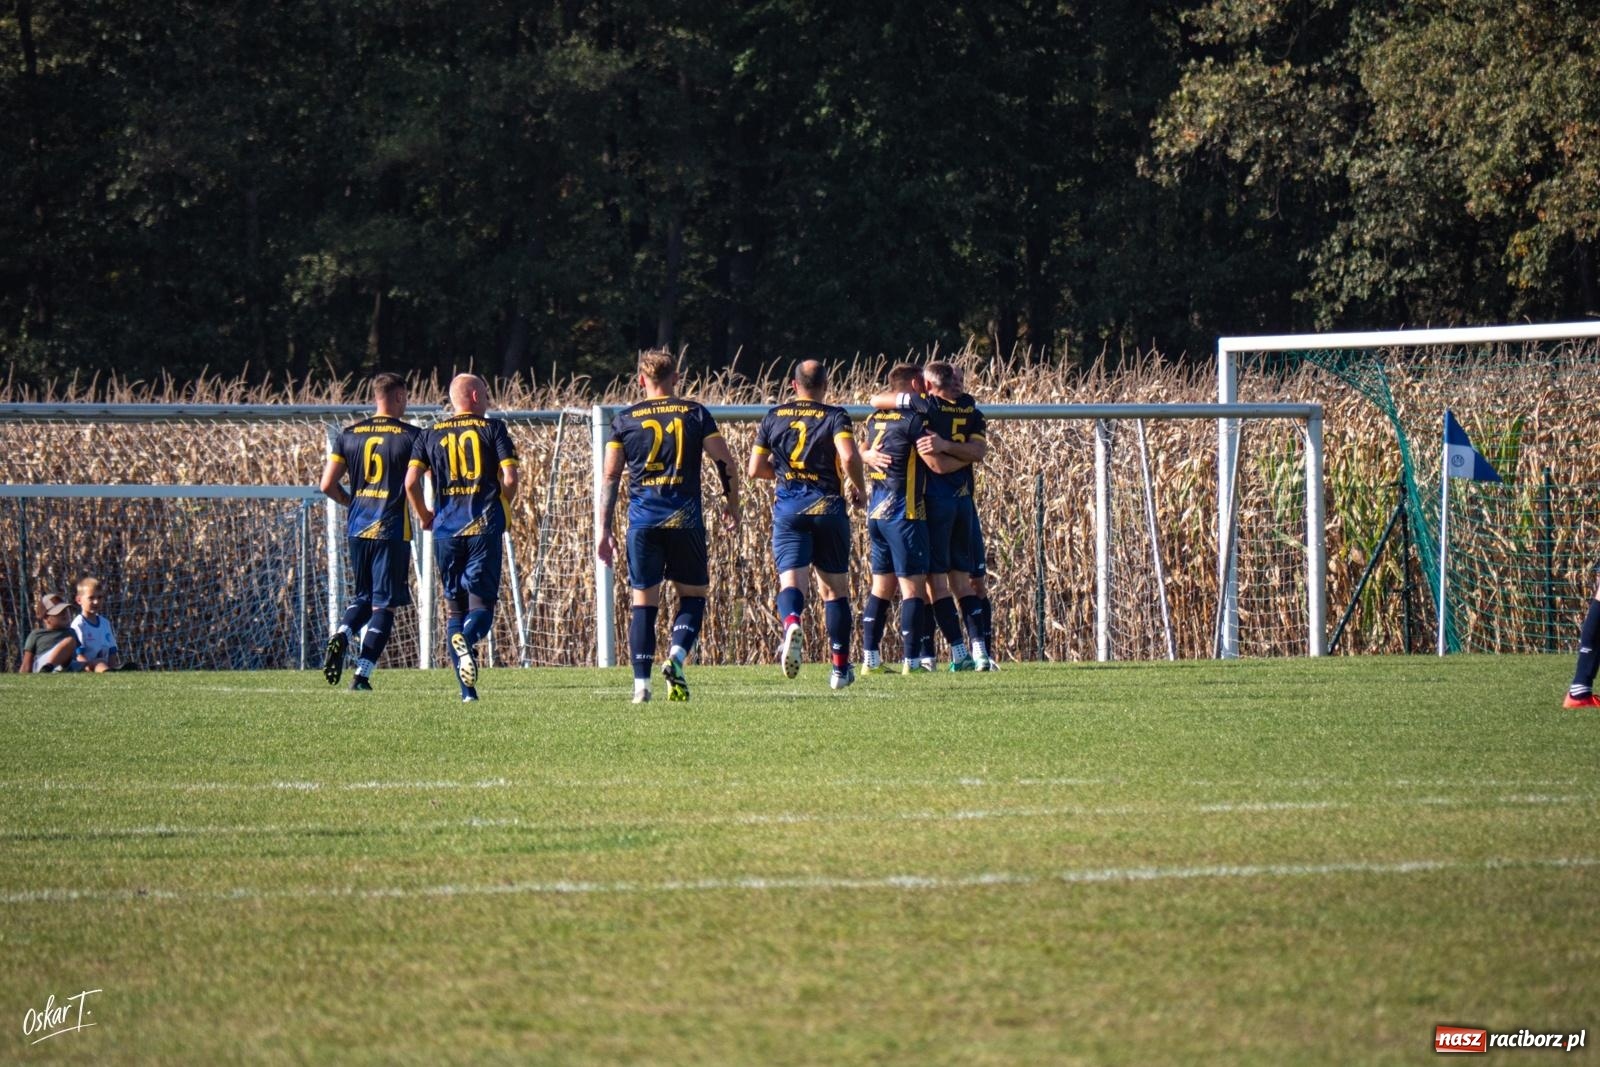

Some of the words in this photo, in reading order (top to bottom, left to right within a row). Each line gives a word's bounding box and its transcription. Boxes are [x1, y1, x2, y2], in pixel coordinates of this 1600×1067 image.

[440, 430, 482, 481] 10
[641, 417, 684, 471] 21
[789, 420, 807, 470] 2
[951, 418, 967, 443] 5
[363, 436, 385, 484] 6
